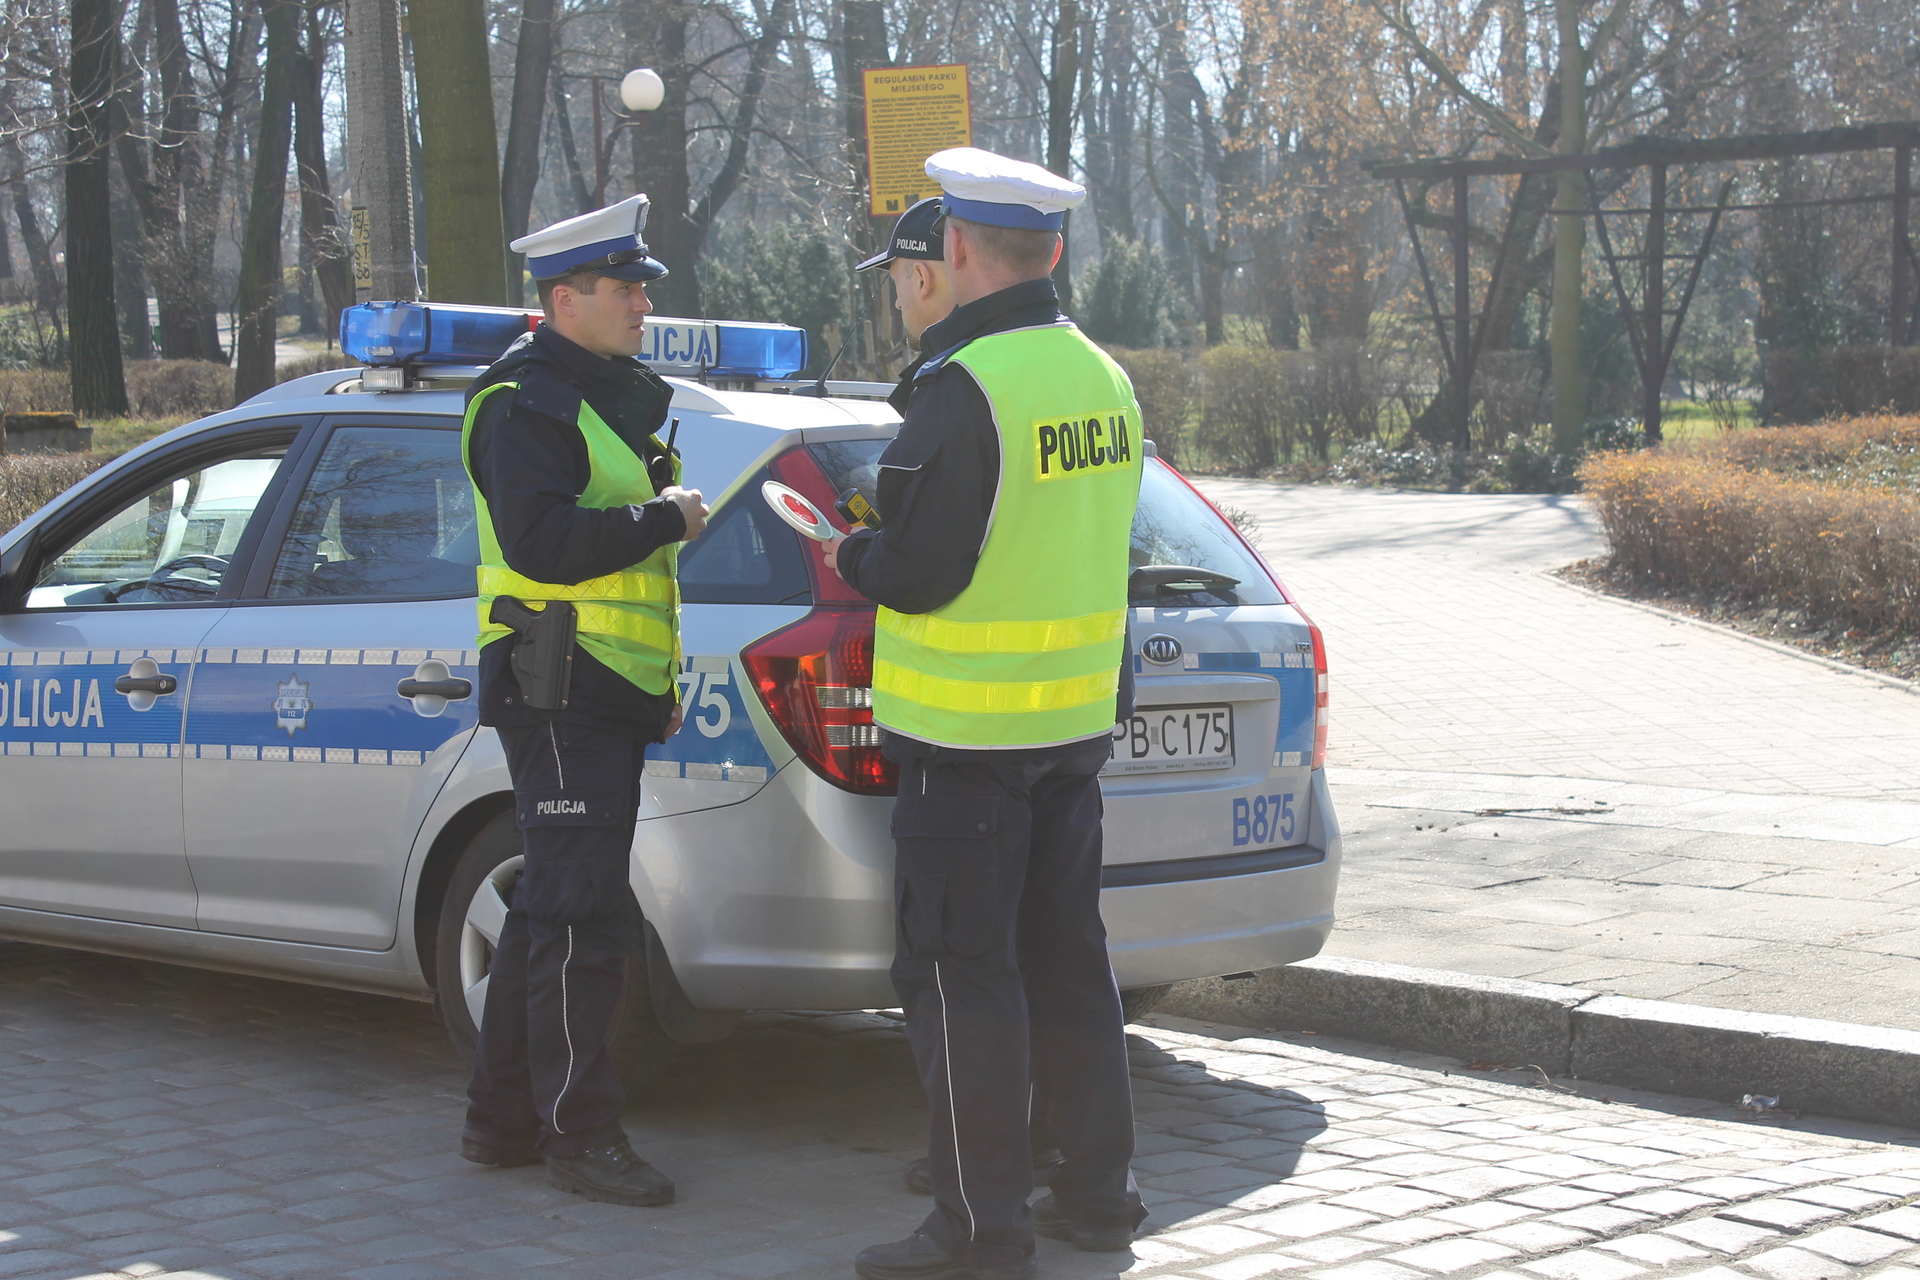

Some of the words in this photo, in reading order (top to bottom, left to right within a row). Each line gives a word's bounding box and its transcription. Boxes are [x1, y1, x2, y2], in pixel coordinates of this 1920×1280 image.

[874, 75, 926, 84] REGULAMIN
[929, 73, 957, 81] PARKU
[891, 83, 944, 92] MIEJSKIEGO
[896, 238, 927, 252] POLICJA
[1038, 415, 1131, 475] POLICJA
[1148, 640, 1178, 658] KIA
[282, 689, 304, 697] POLICJA
[1162, 712, 1227, 756] C175
[537, 800, 586, 815] POLICJA
[1232, 793, 1295, 847] B875
